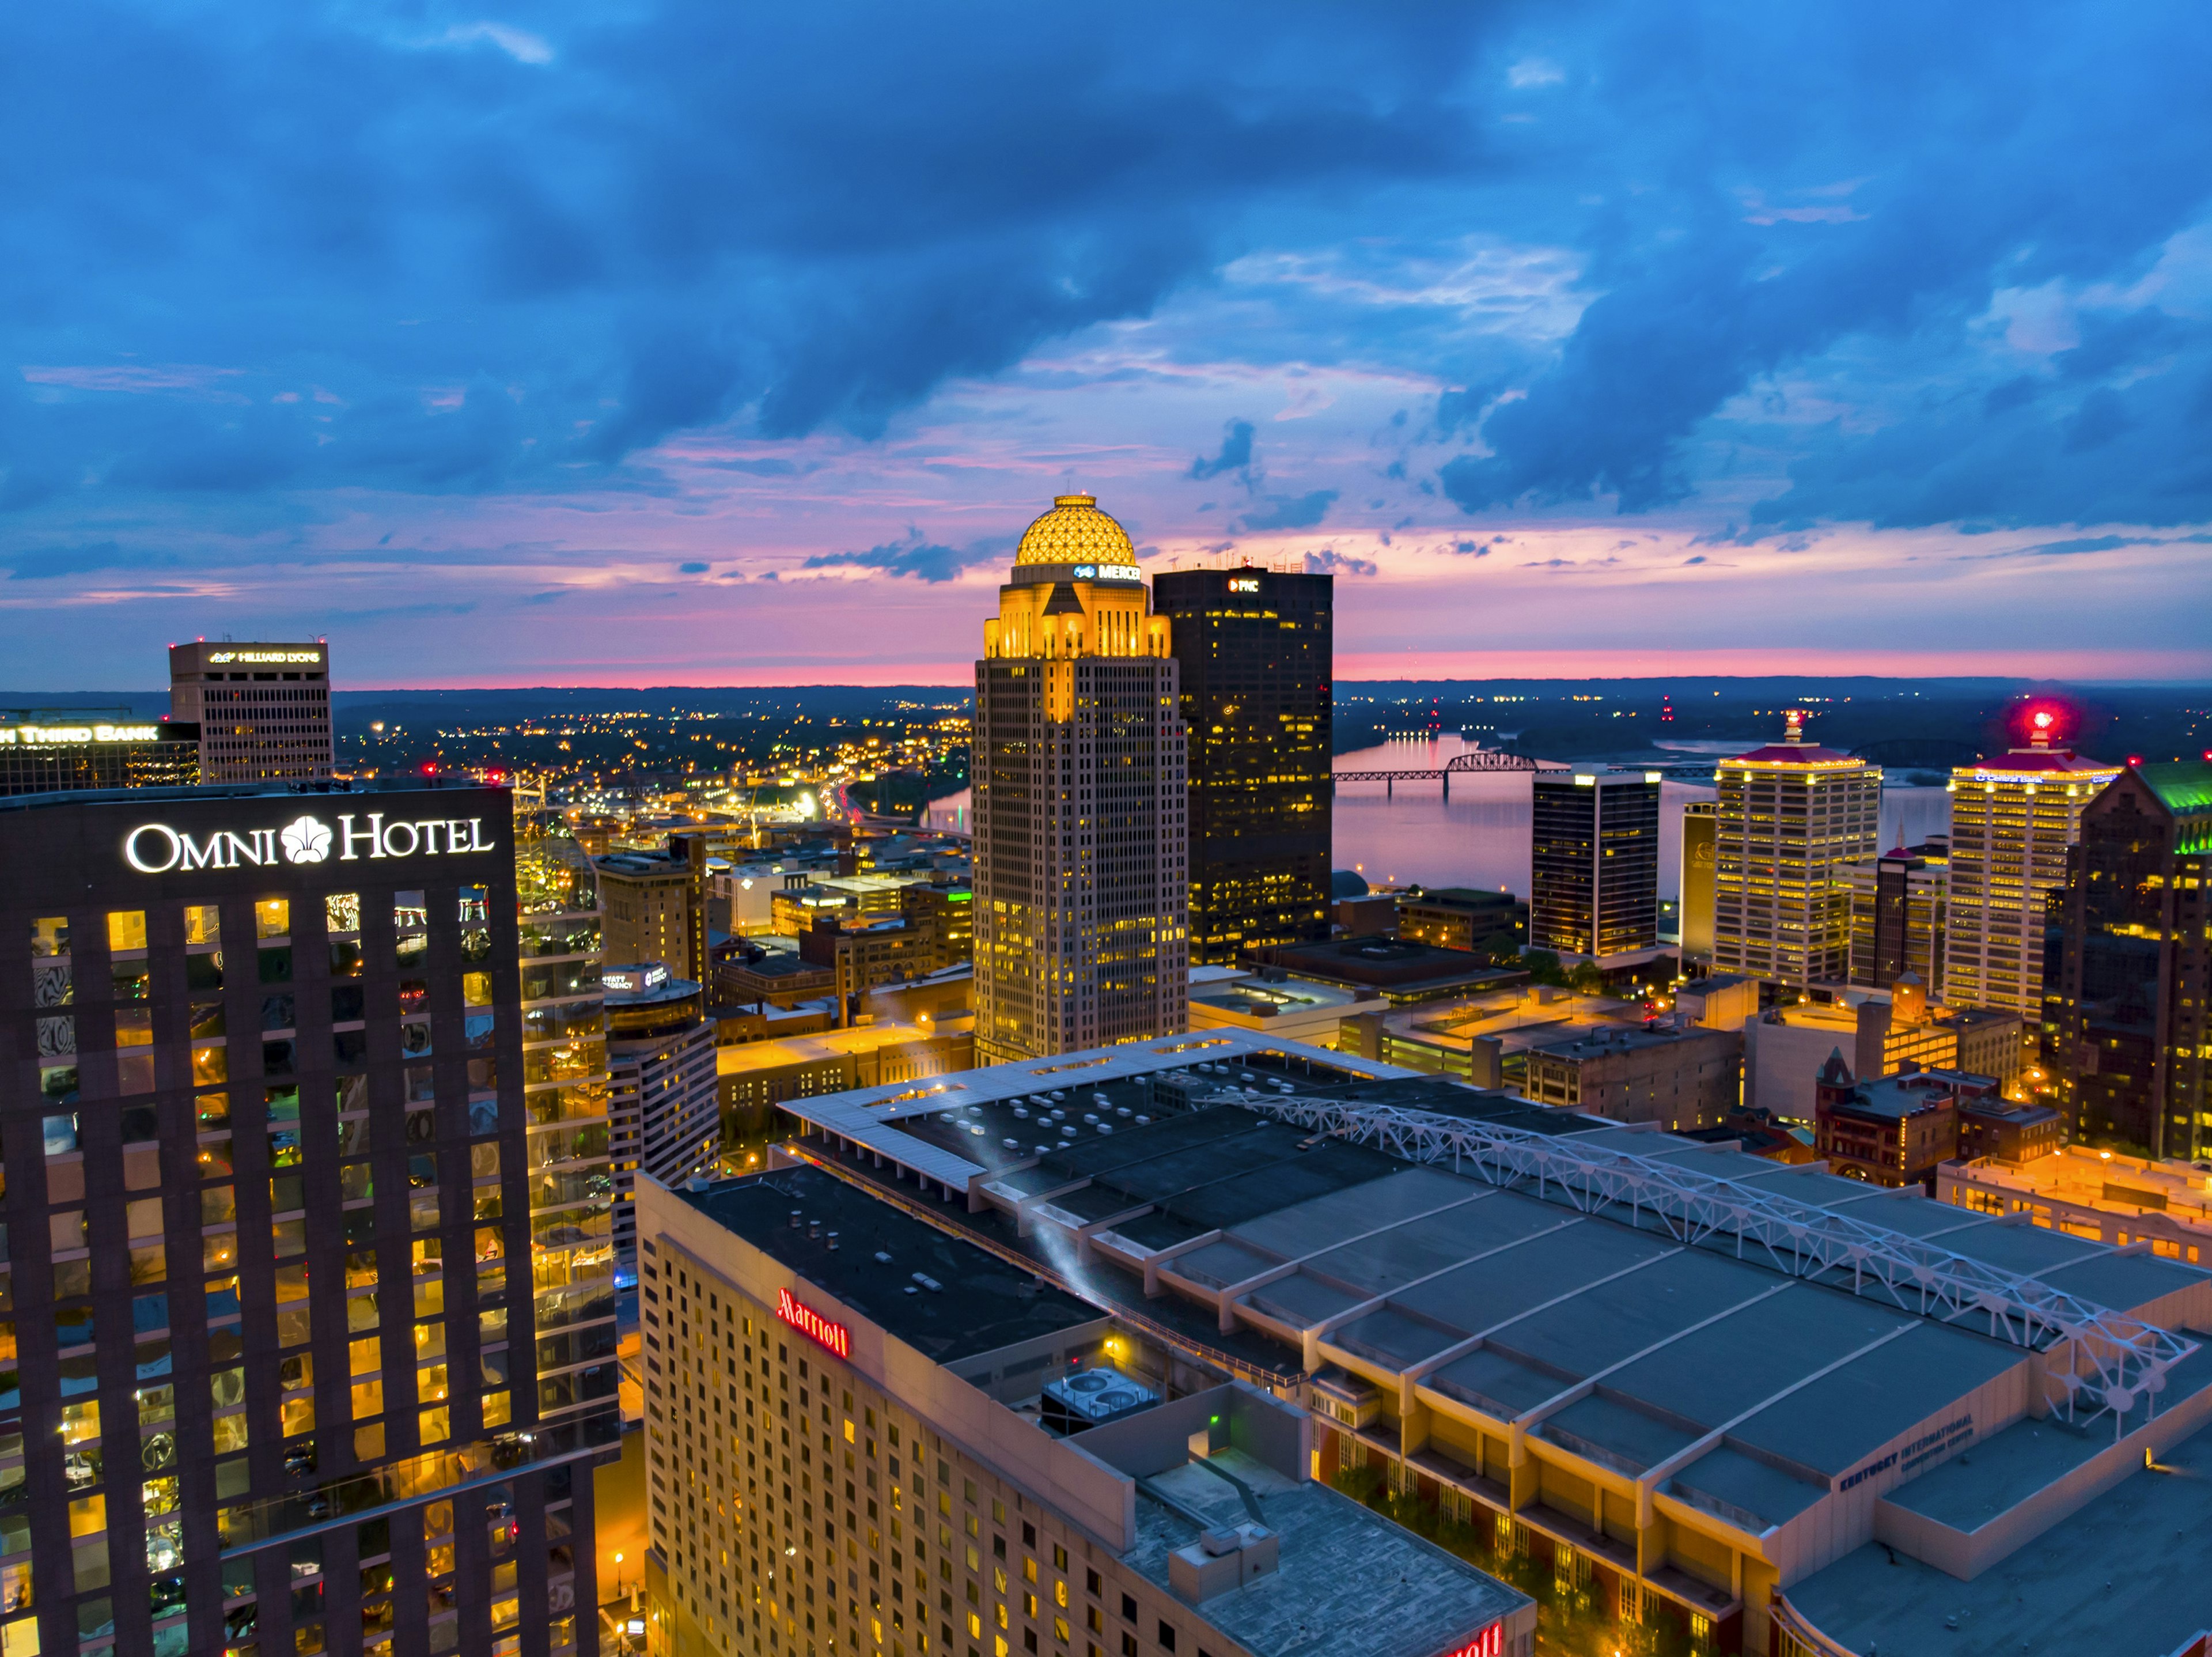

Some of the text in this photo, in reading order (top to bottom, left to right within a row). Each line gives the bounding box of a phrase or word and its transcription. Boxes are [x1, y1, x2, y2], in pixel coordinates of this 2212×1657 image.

[1238, 580, 1259, 592] PNC
[238, 652, 320, 663] HILLIARD LYONS
[18, 727, 92, 743] THIRD
[94, 726, 158, 741] BANK
[1987, 774, 2018, 782] Central
[125, 813, 495, 873] OMNI HOTEL
[777, 1287, 849, 1358] Marriott
[1840, 1414, 1973, 1492] KENTUCKY INTERNATIONAL
